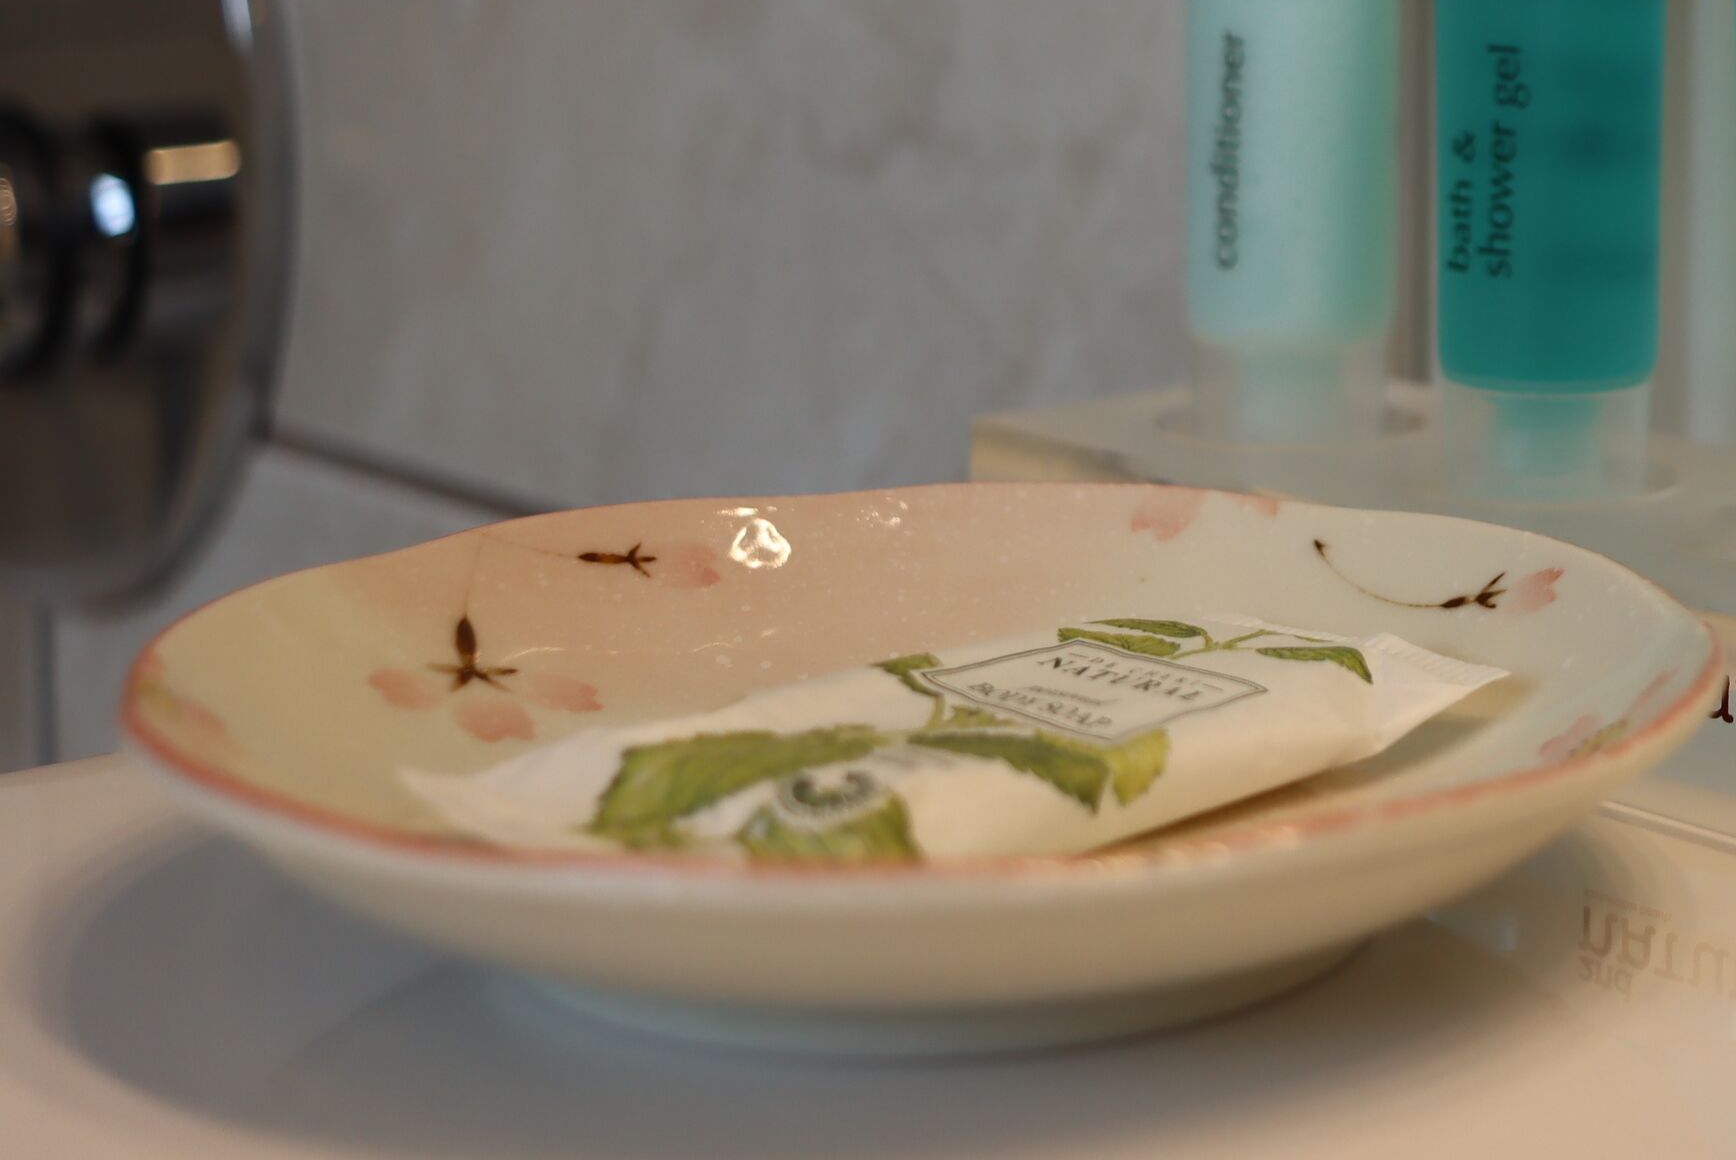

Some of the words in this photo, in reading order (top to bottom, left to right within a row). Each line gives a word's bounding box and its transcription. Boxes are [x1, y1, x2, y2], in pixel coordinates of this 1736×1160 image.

[1486, 42, 1532, 109] gel
[1210, 29, 1246, 272] conditioner
[1451, 130, 1477, 164] &
[1447, 177, 1474, 274] bath
[1478, 121, 1518, 279] shower
